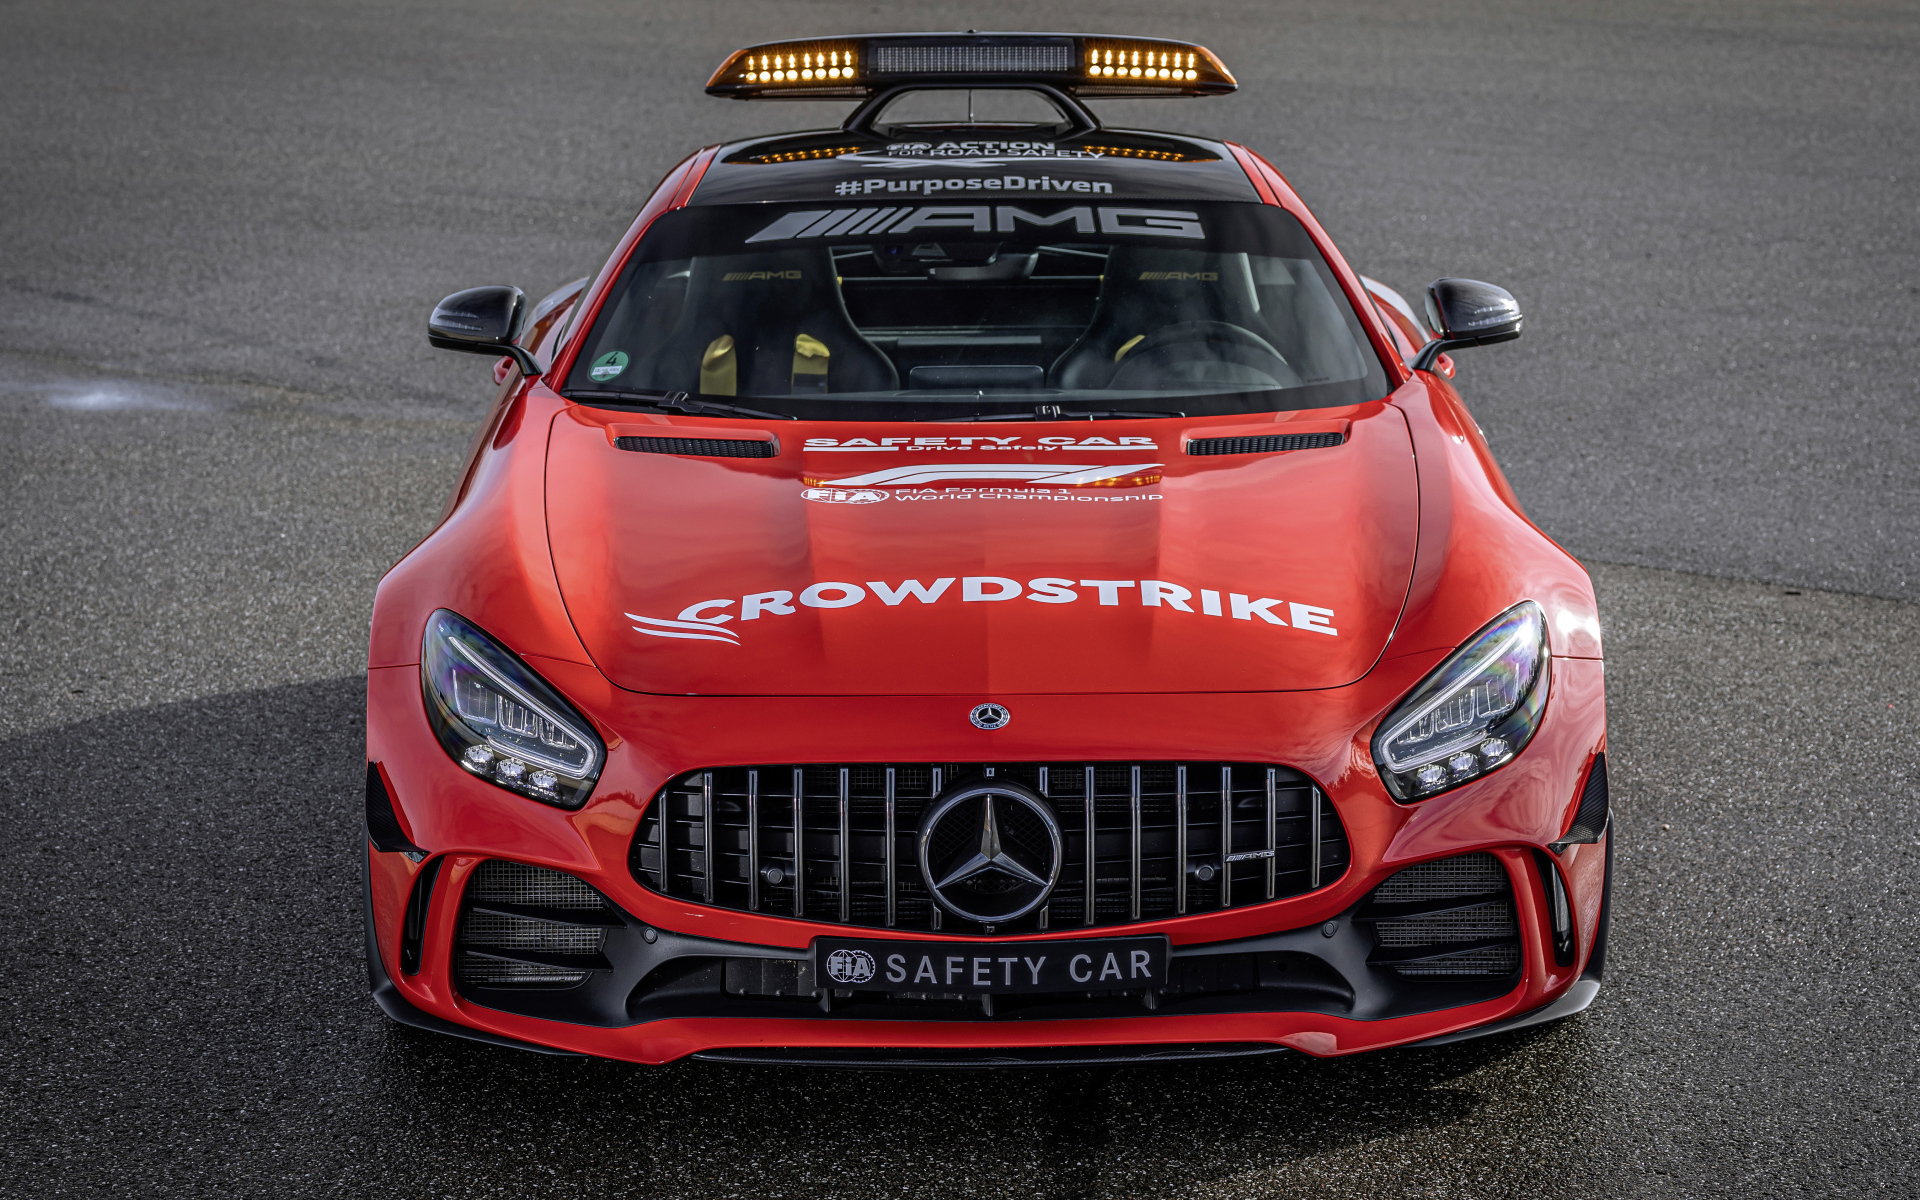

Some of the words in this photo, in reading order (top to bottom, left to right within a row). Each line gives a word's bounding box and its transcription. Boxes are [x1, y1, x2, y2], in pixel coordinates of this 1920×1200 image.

[936, 141, 1056, 150] ACTION
[930, 149, 1000, 157] ROAD
[1007, 149, 1105, 159] SAFETY
[835, 176, 1113, 195] #PurposeDriven
[888, 206, 1205, 240] AMG
[748, 270, 802, 280] AMG
[1164, 272, 1219, 281] AMG
[605, 351, 619, 366] 4
[804, 437, 1022, 447] SAFETY
[1037, 436, 1157, 446] CAR
[978, 493, 1165, 502] Championship
[677, 577, 1339, 637] CROWDSTRIKE
[885, 953, 1048, 986] SAFETY
[1068, 949, 1153, 983] CAR
